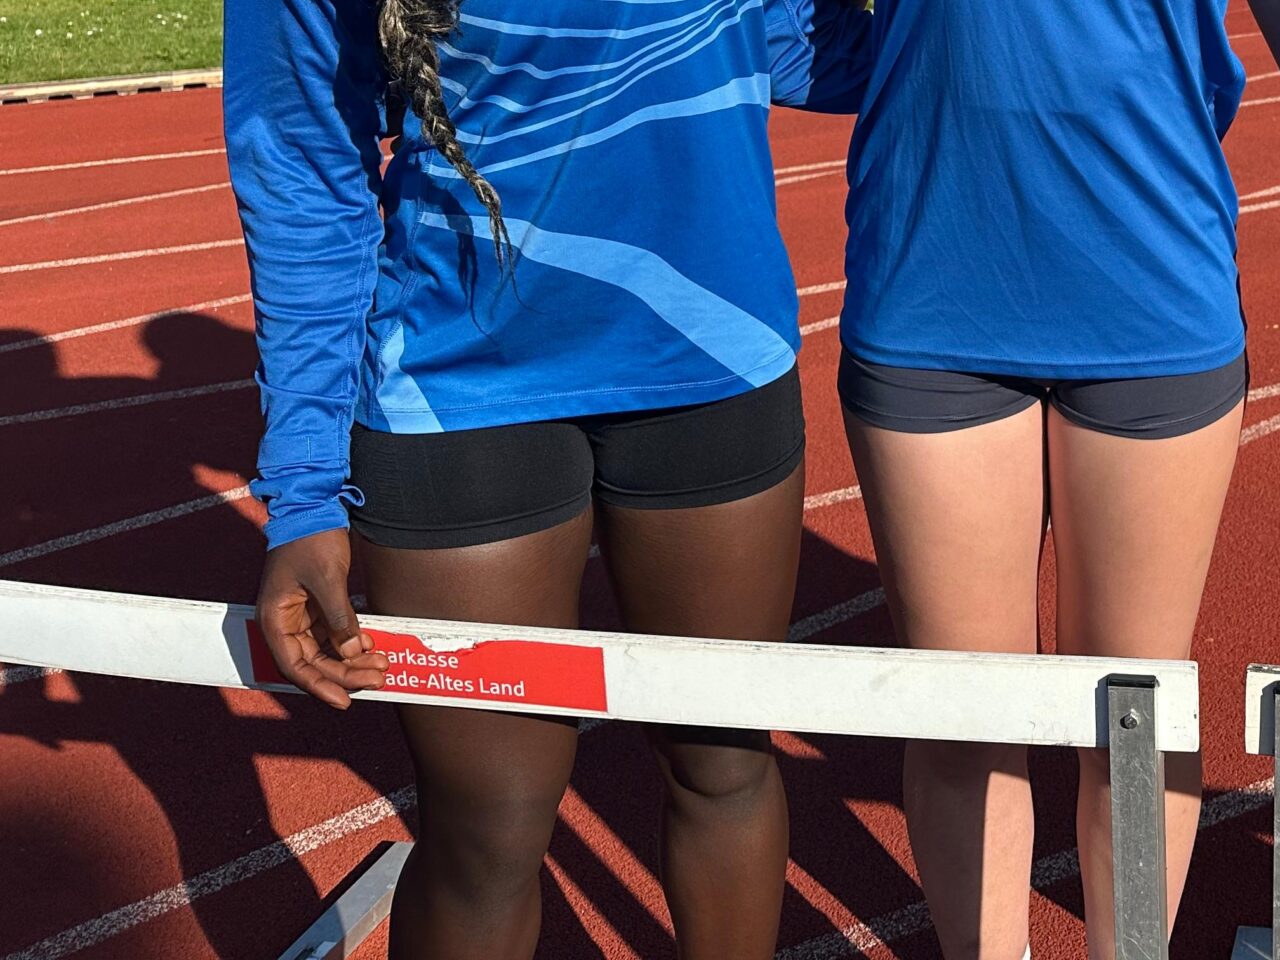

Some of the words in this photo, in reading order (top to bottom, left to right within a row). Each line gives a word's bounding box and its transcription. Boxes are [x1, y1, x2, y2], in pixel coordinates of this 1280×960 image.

[368, 648, 459, 668] arkasse
[384, 671, 474, 692] ade-Altes
[479, 677, 525, 697] Land
